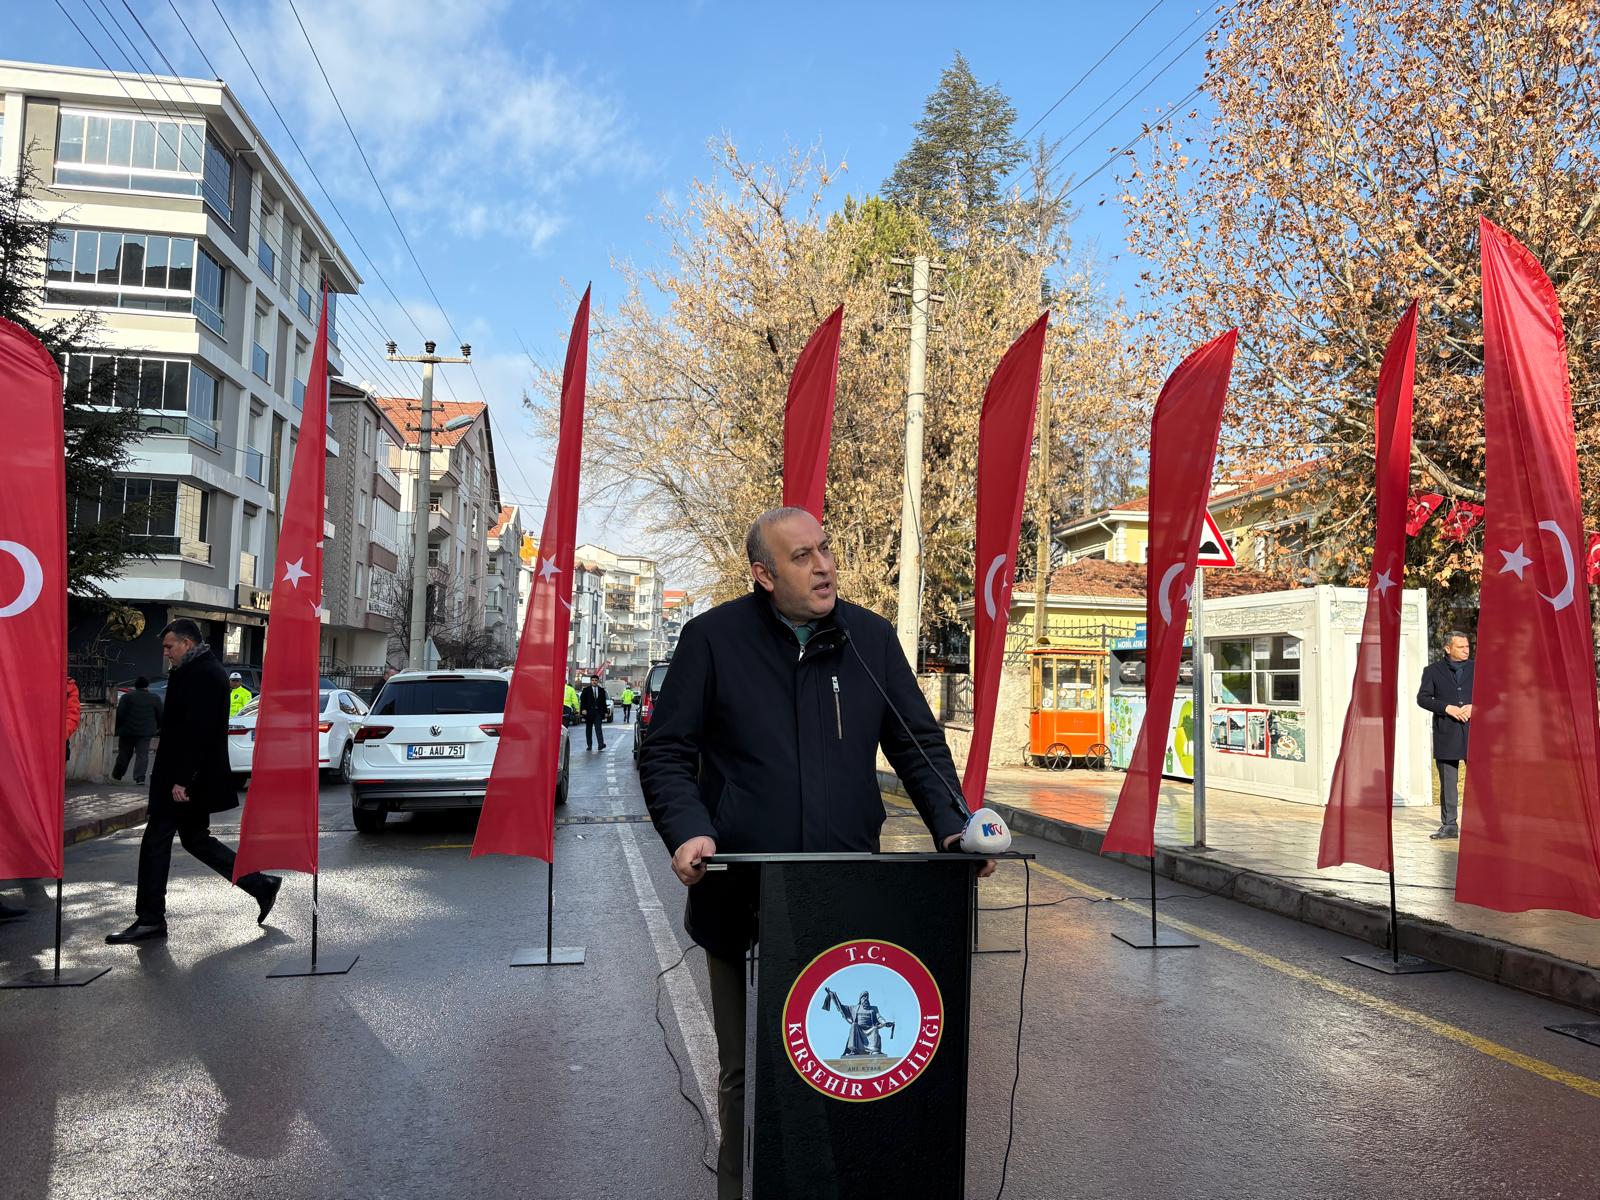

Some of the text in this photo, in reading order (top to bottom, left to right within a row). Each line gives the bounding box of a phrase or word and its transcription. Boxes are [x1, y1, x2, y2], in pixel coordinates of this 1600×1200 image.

[413, 746, 462, 756] 40 AAU 751
[982, 823, 1003, 837] KTV
[845, 945, 886, 962] T.C.
[788, 1014, 940, 1097] KIRŞEHİR VALİLİĞİ
